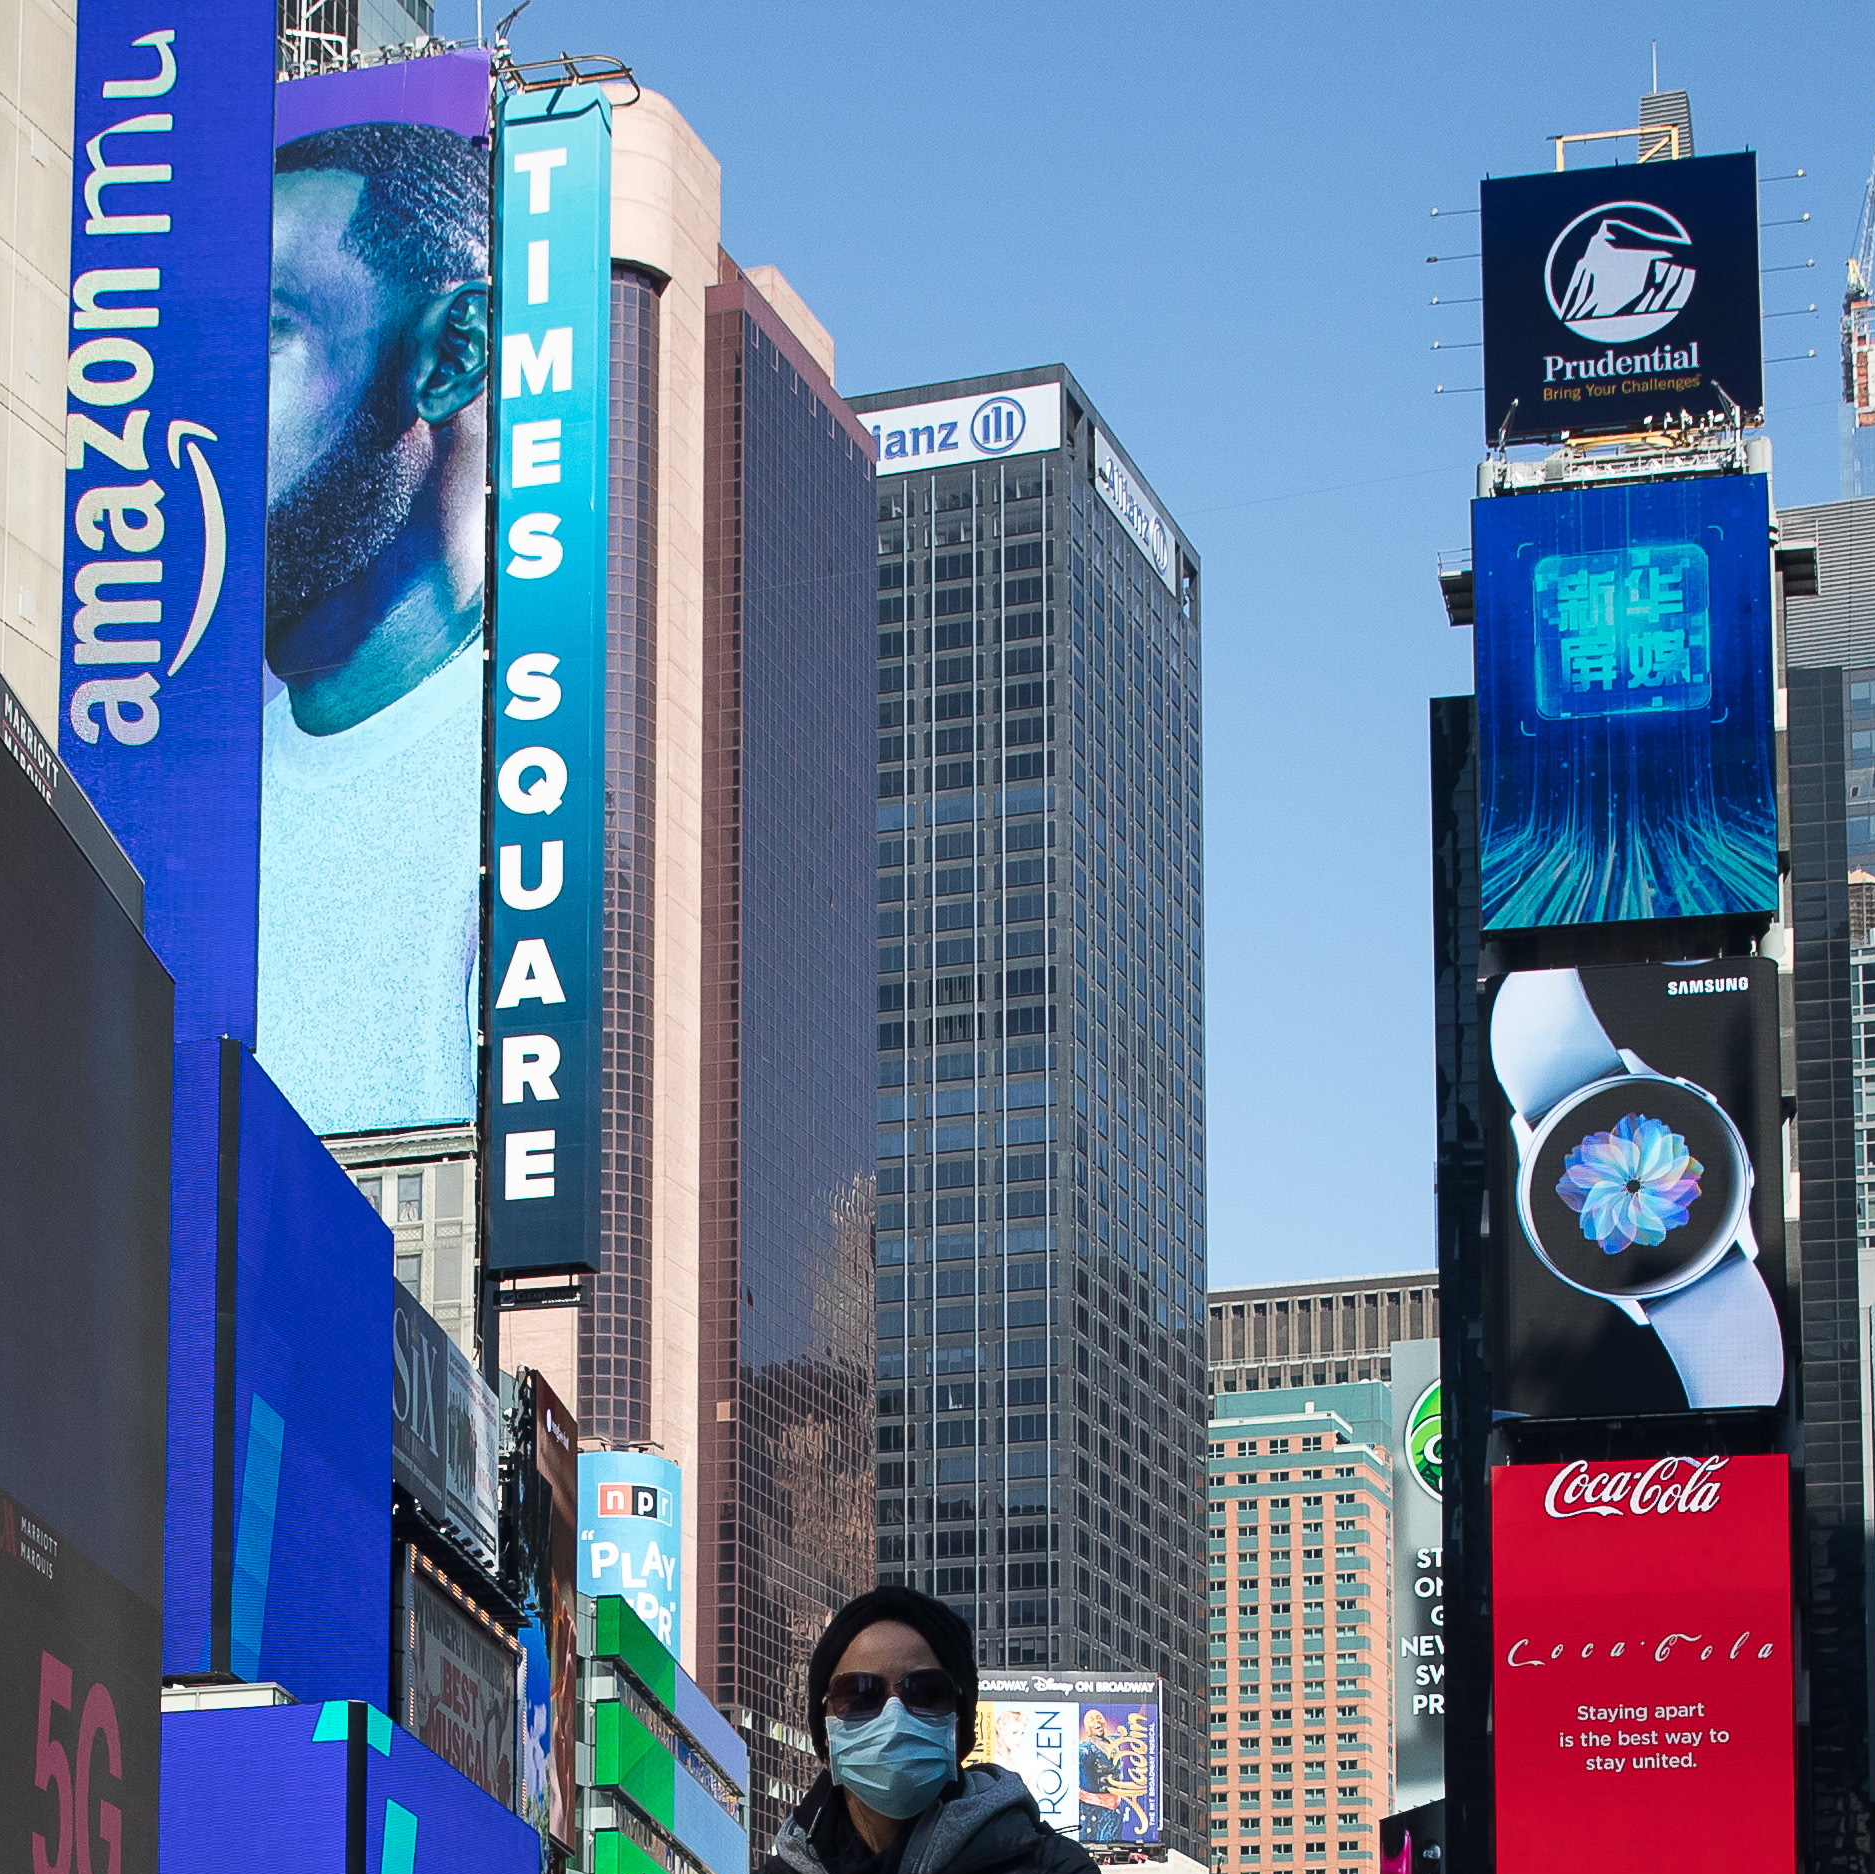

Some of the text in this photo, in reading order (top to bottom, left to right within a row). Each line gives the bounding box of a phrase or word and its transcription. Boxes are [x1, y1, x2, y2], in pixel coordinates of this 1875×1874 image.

[1542, 342, 1699, 383] Prudential
[1542, 376, 1698, 402] Bring Your Challenges
[876, 420, 959, 461] ianz
[66, 267, 163, 746] amazon
[1556, 566, 1685, 633] 新华
[494, 147, 574, 1201] TIMES SQUARE
[5, 693, 60, 789] MARRIOTT
[1667, 976, 1749, 995] SAMSUNG
[20, 1515, 58, 1556] MARRIOTT
[19, 1540, 55, 1581] MARQUIS
[442, 1656, 479, 1730] BEST
[978, 1675, 1156, 1696] OADWAY, Disney ON BROADWAY
[1576, 1702, 1706, 1725] Staying apart
[1558, 1728, 1731, 1750] is the best way to
[1035, 1710, 1069, 1815] ROZEN
[1585, 1752, 1698, 1773] stay united.
